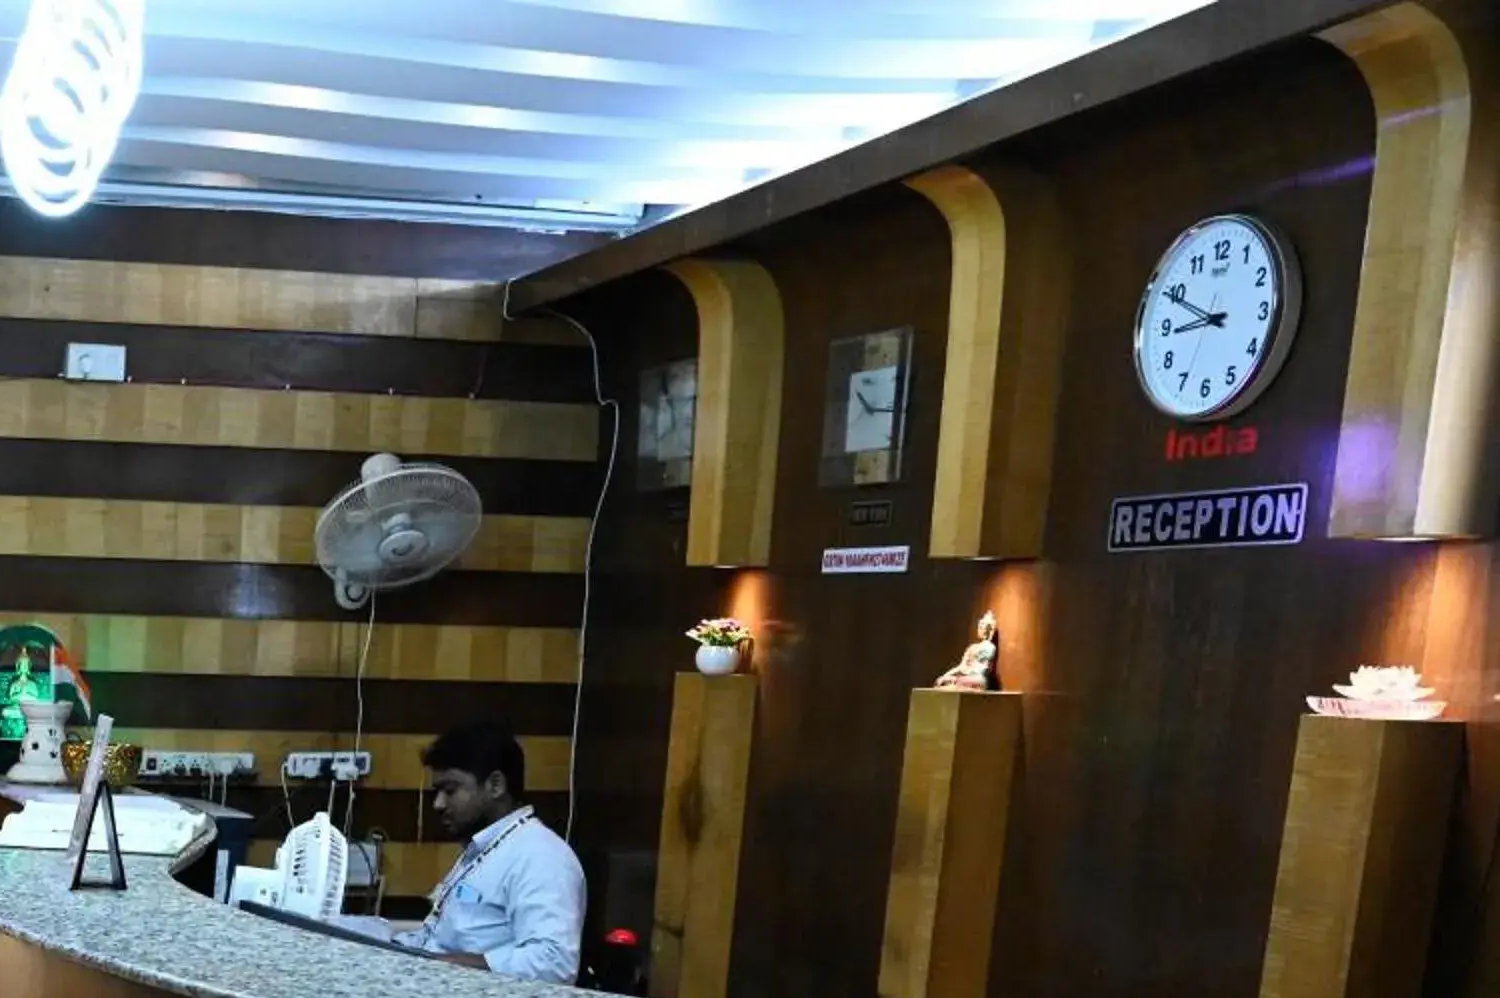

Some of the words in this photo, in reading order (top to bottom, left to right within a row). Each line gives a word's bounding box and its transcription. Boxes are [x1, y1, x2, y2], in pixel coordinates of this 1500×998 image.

[1213, 239, 1231, 261] 12
[1242, 243, 1251, 264] 1
[1190, 254, 1204, 275] 11
[1255, 266, 1267, 288] 2
[1169, 283, 1186, 304] 10
[1257, 301, 1269, 321] 3
[1161, 318, 1171, 337] 9
[1245, 337, 1257, 357] 4
[1163, 350, 1174, 369] 8
[1178, 371, 1189, 392] 7
[1225, 365, 1236, 386] 5
[1200, 378, 1211, 398] 6
[1165, 424, 1258, 461] India
[1114, 492, 1300, 544] RECEPTION
